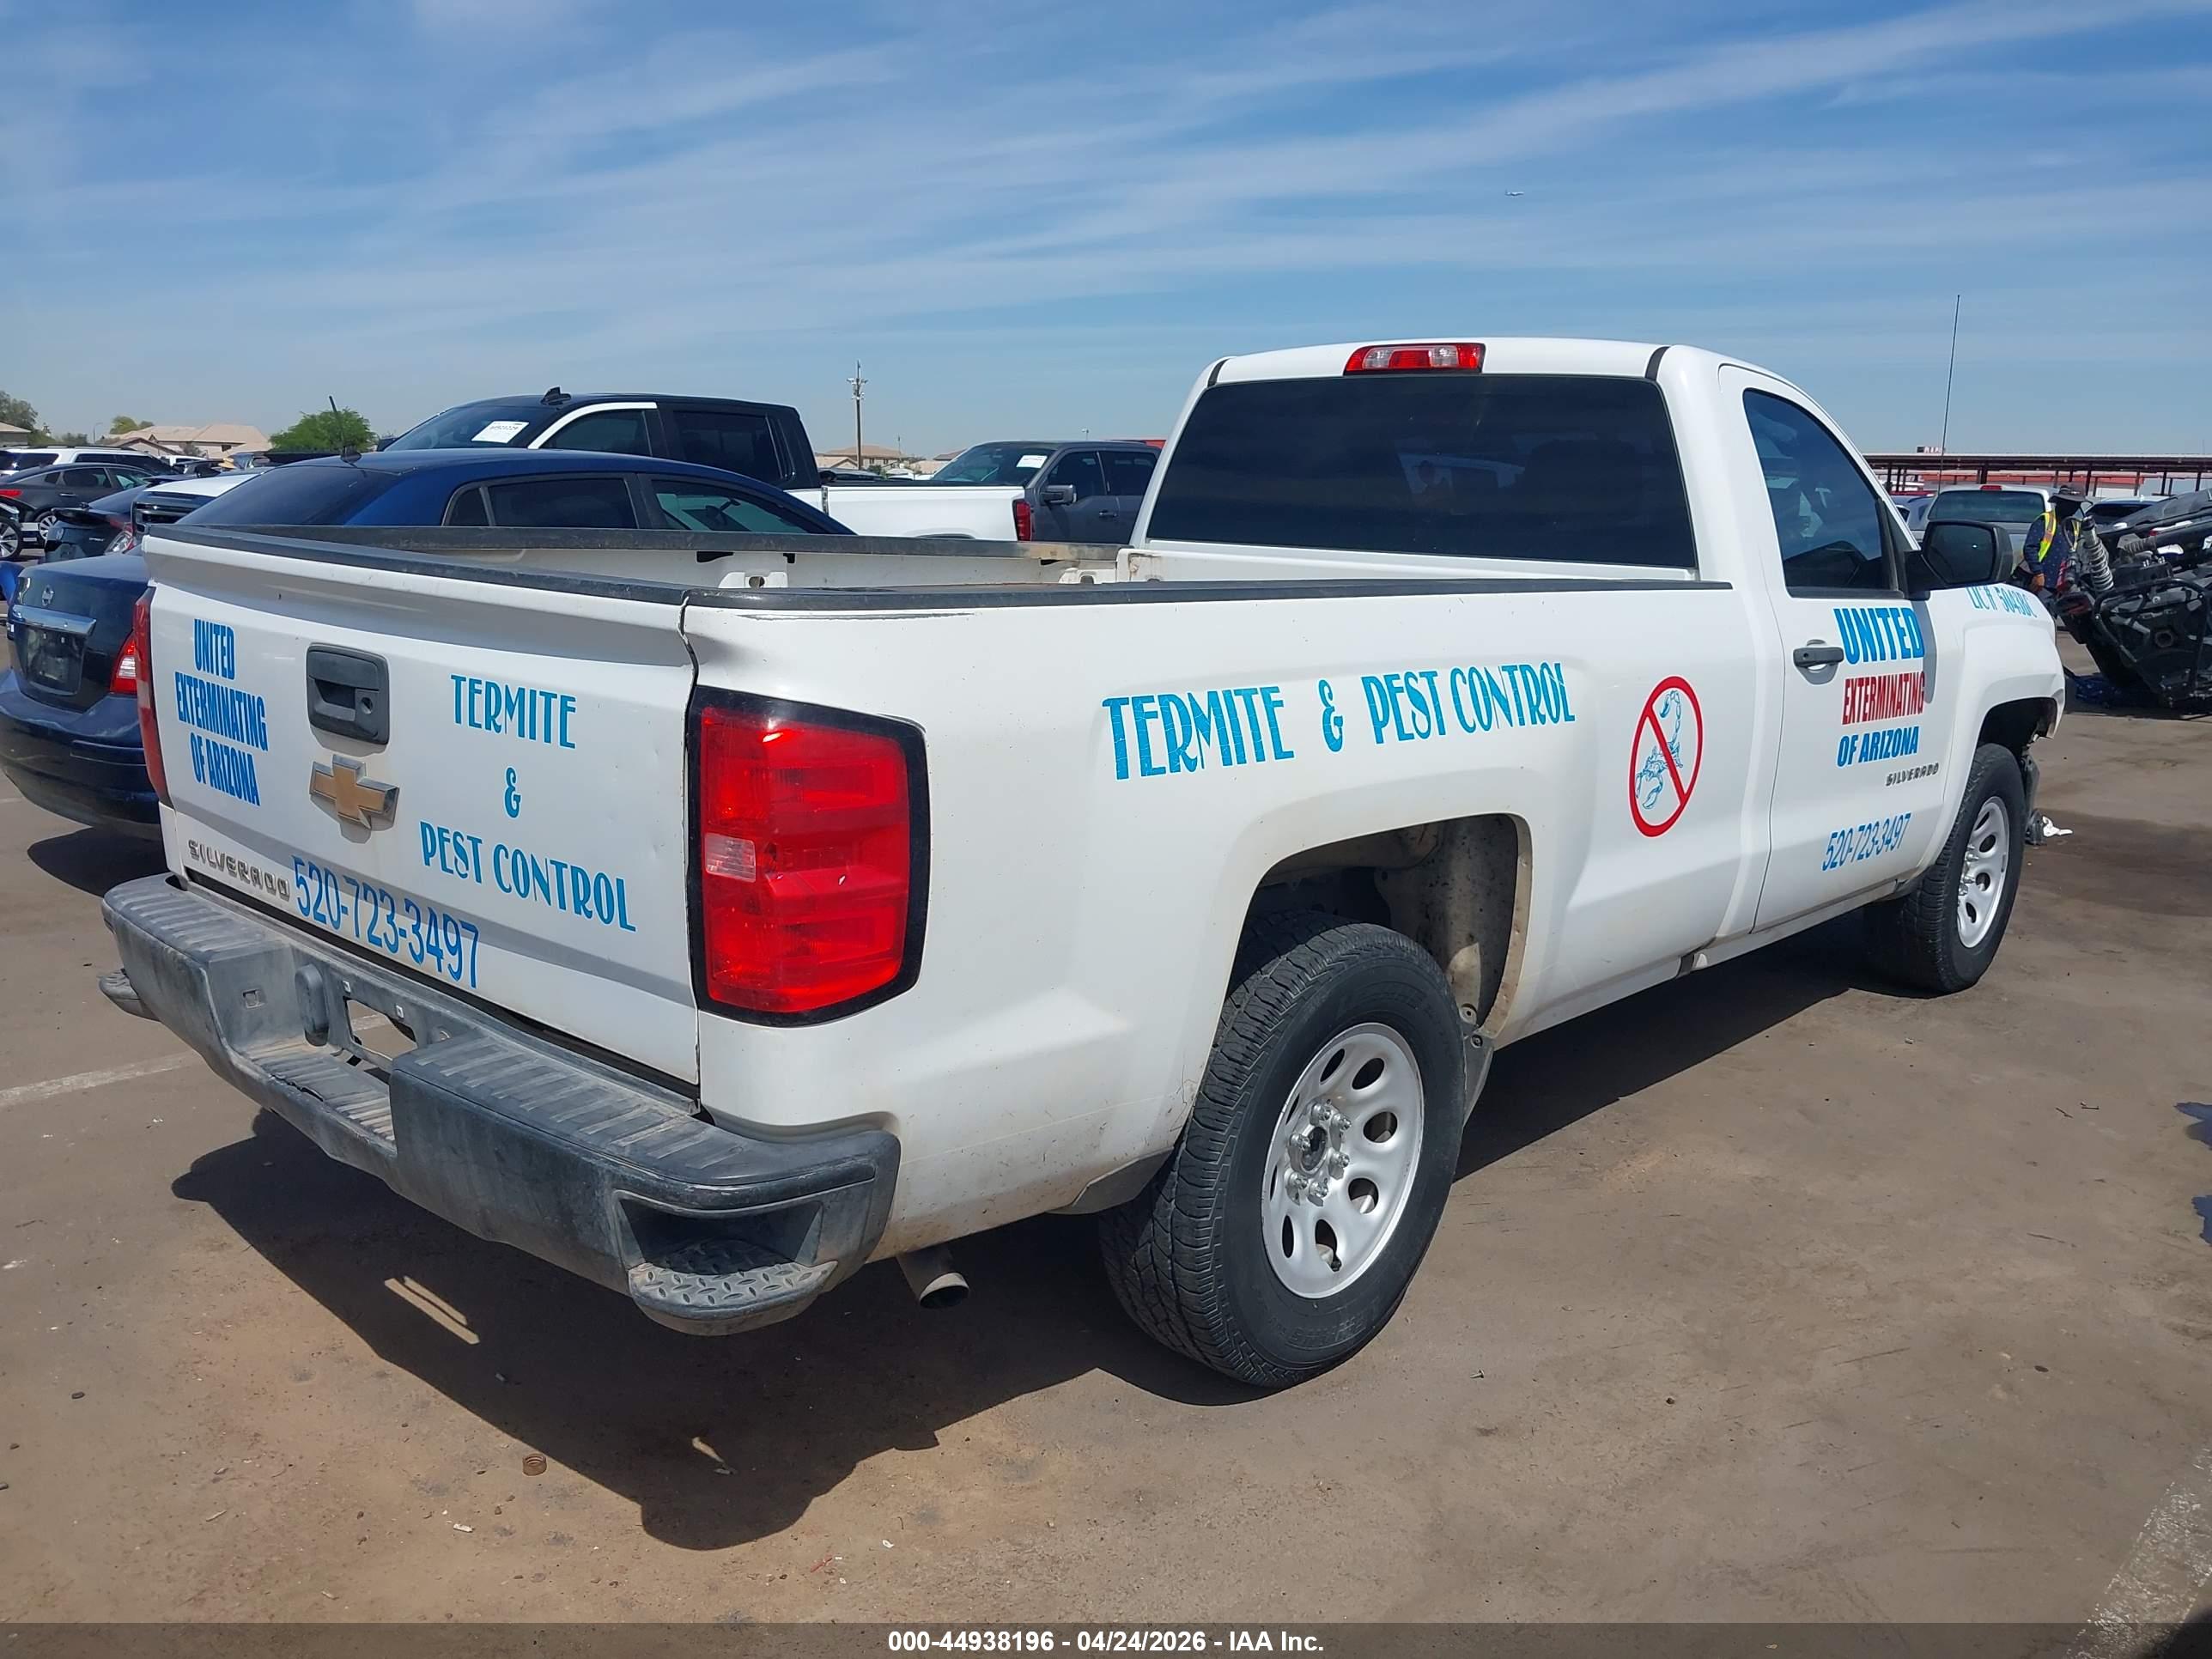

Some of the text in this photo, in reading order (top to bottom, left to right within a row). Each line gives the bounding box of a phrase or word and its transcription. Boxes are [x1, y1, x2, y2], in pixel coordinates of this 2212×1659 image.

[194, 618, 235, 680] UNITED
[1833, 607, 1925, 665] UNITED
[174, 671, 269, 751] EXTERMINATING
[450, 674, 577, 750] TERMITE
[1102, 662, 1576, 781] TERMITE & PEST CONTROL
[1842, 671, 1925, 725] EXTERMINATING
[190, 732, 261, 806] OF ARIZONA
[1837, 726, 1920, 768] OF ARIZONA
[1885, 762, 1940, 787] SILVERADO
[504, 767, 522, 818] &
[188, 839, 291, 902] SILVERADO
[1822, 812, 1911, 872] 520-723-3497
[420, 821, 637, 933] PEST CONTROL
[292, 854, 481, 989] 520-723-3497
